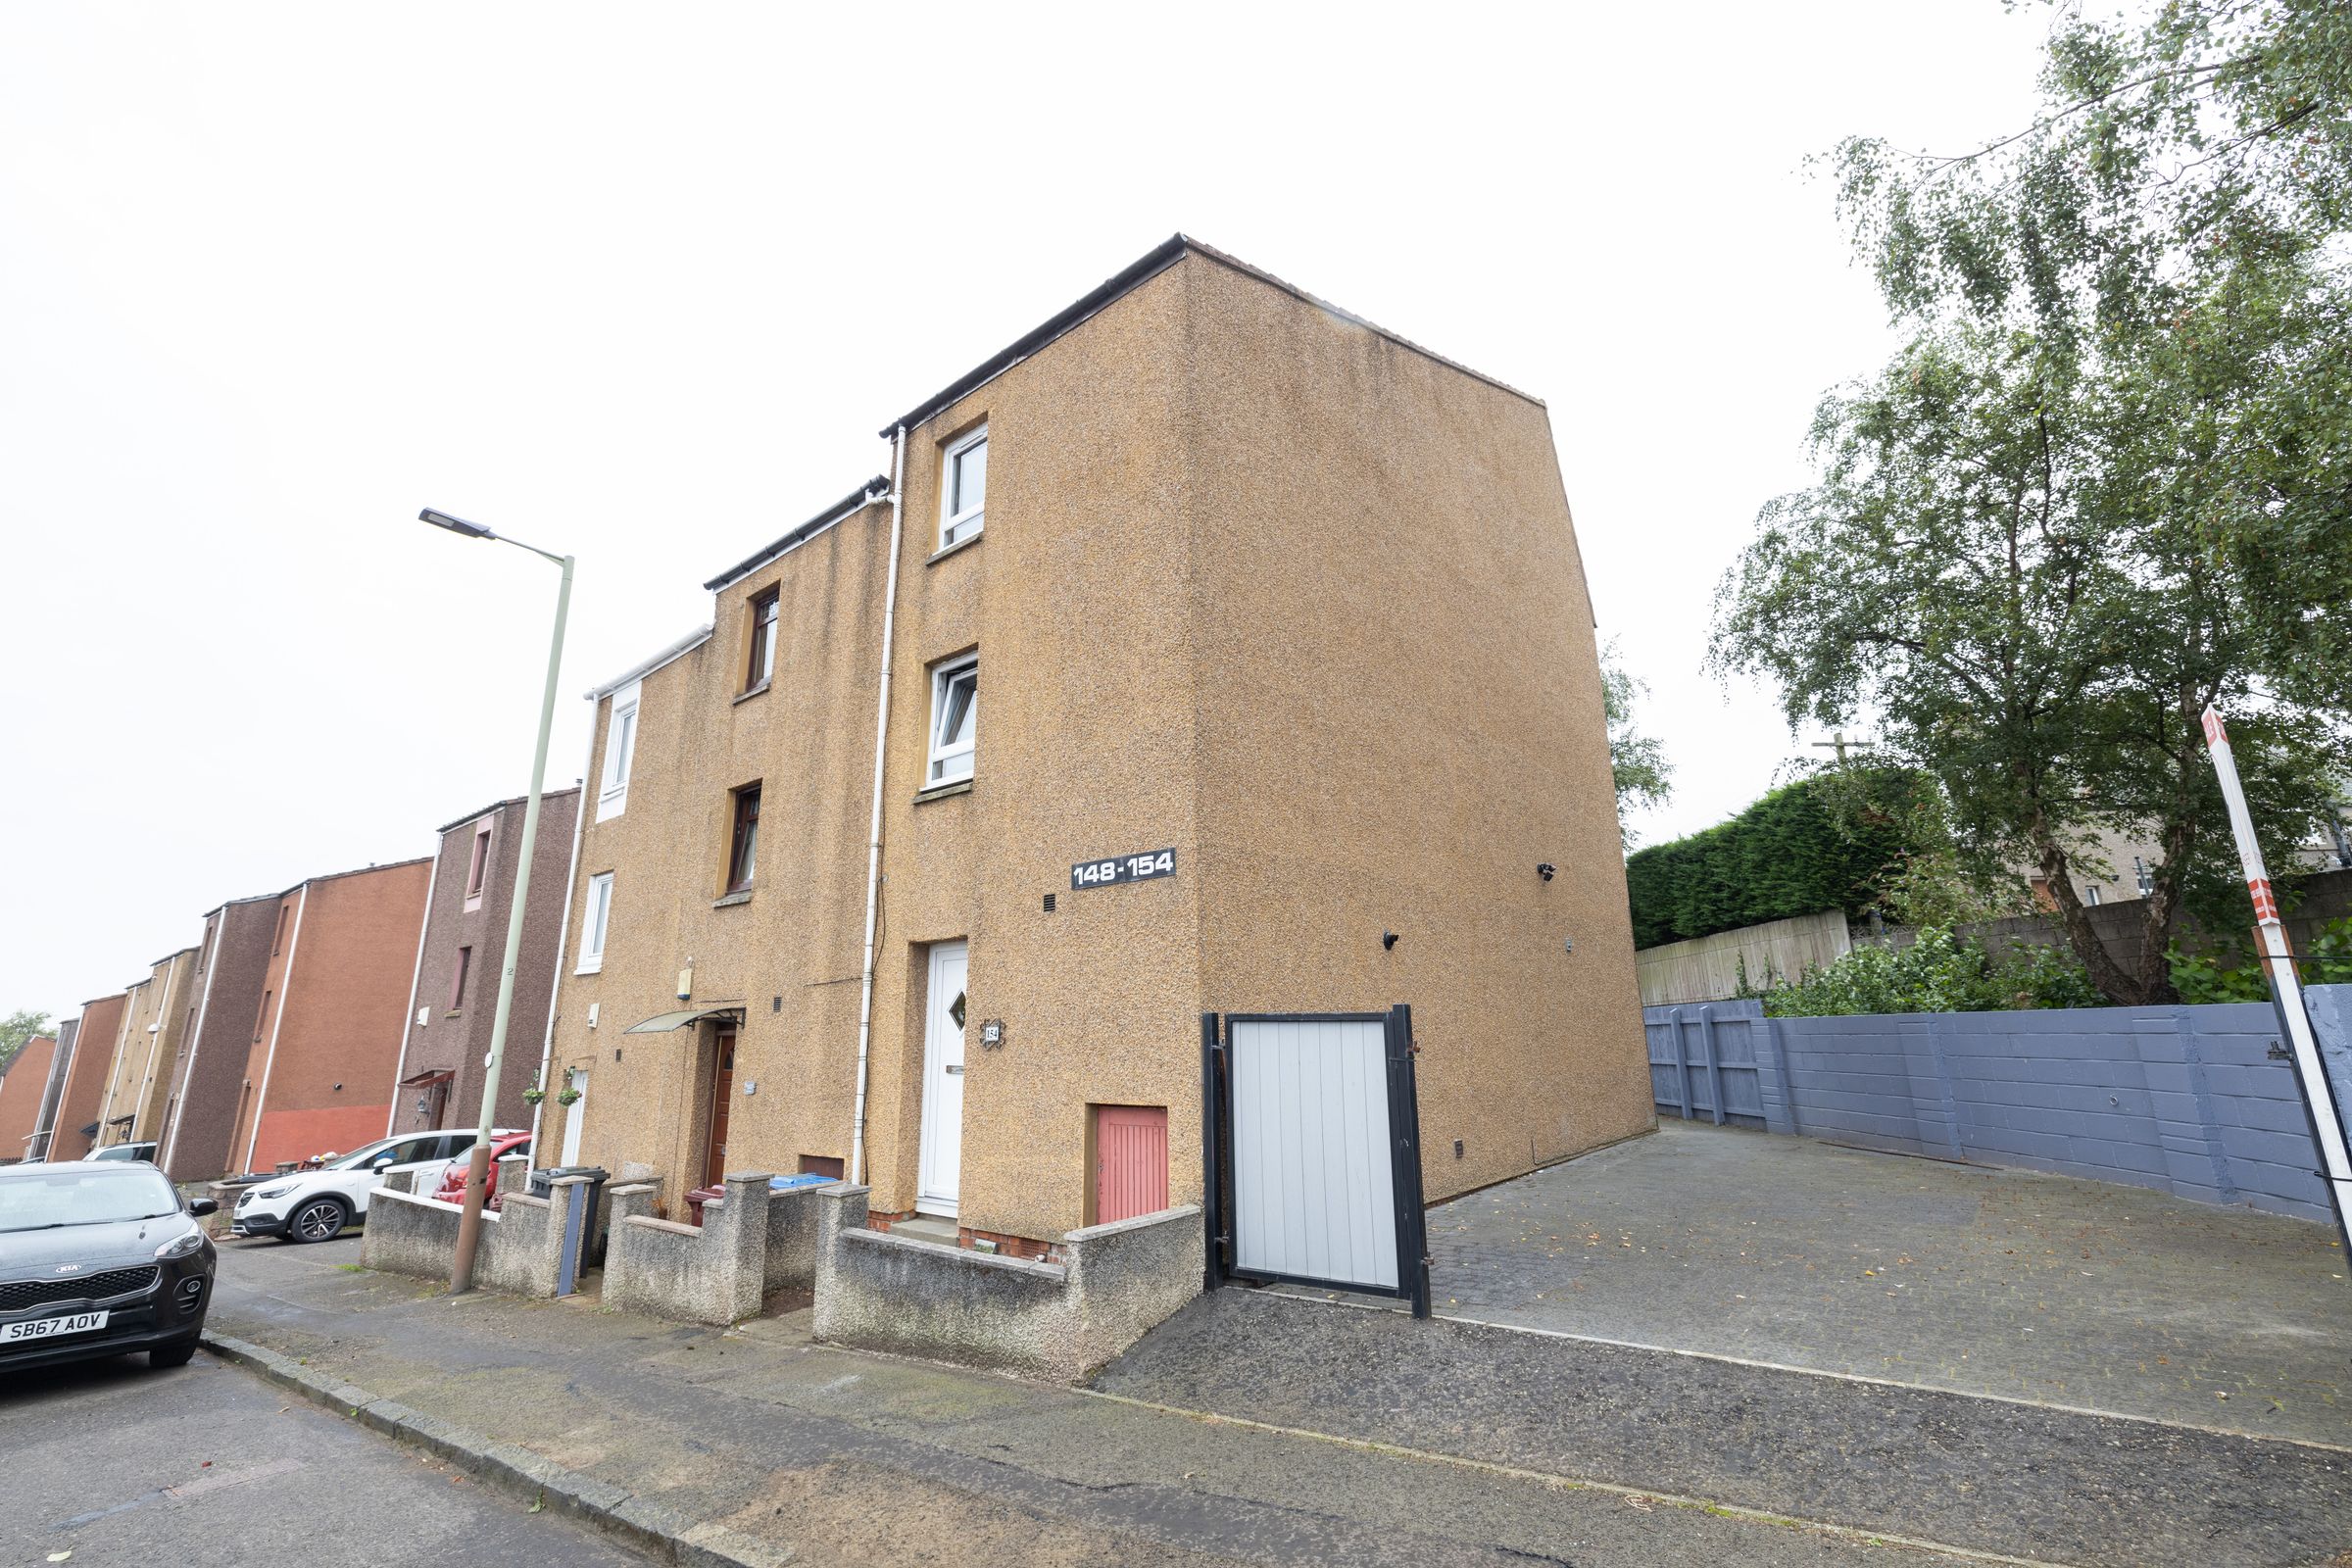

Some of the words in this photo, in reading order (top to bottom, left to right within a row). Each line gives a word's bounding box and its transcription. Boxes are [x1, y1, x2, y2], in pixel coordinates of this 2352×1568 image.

[1073, 852, 1174, 885] 148-154
[987, 1029, 998, 1039] 154
[59, 1264, 79, 1273] KIA
[10, 1319, 61, 1339] SB67
[65, 1313, 101, 1332] AOV
